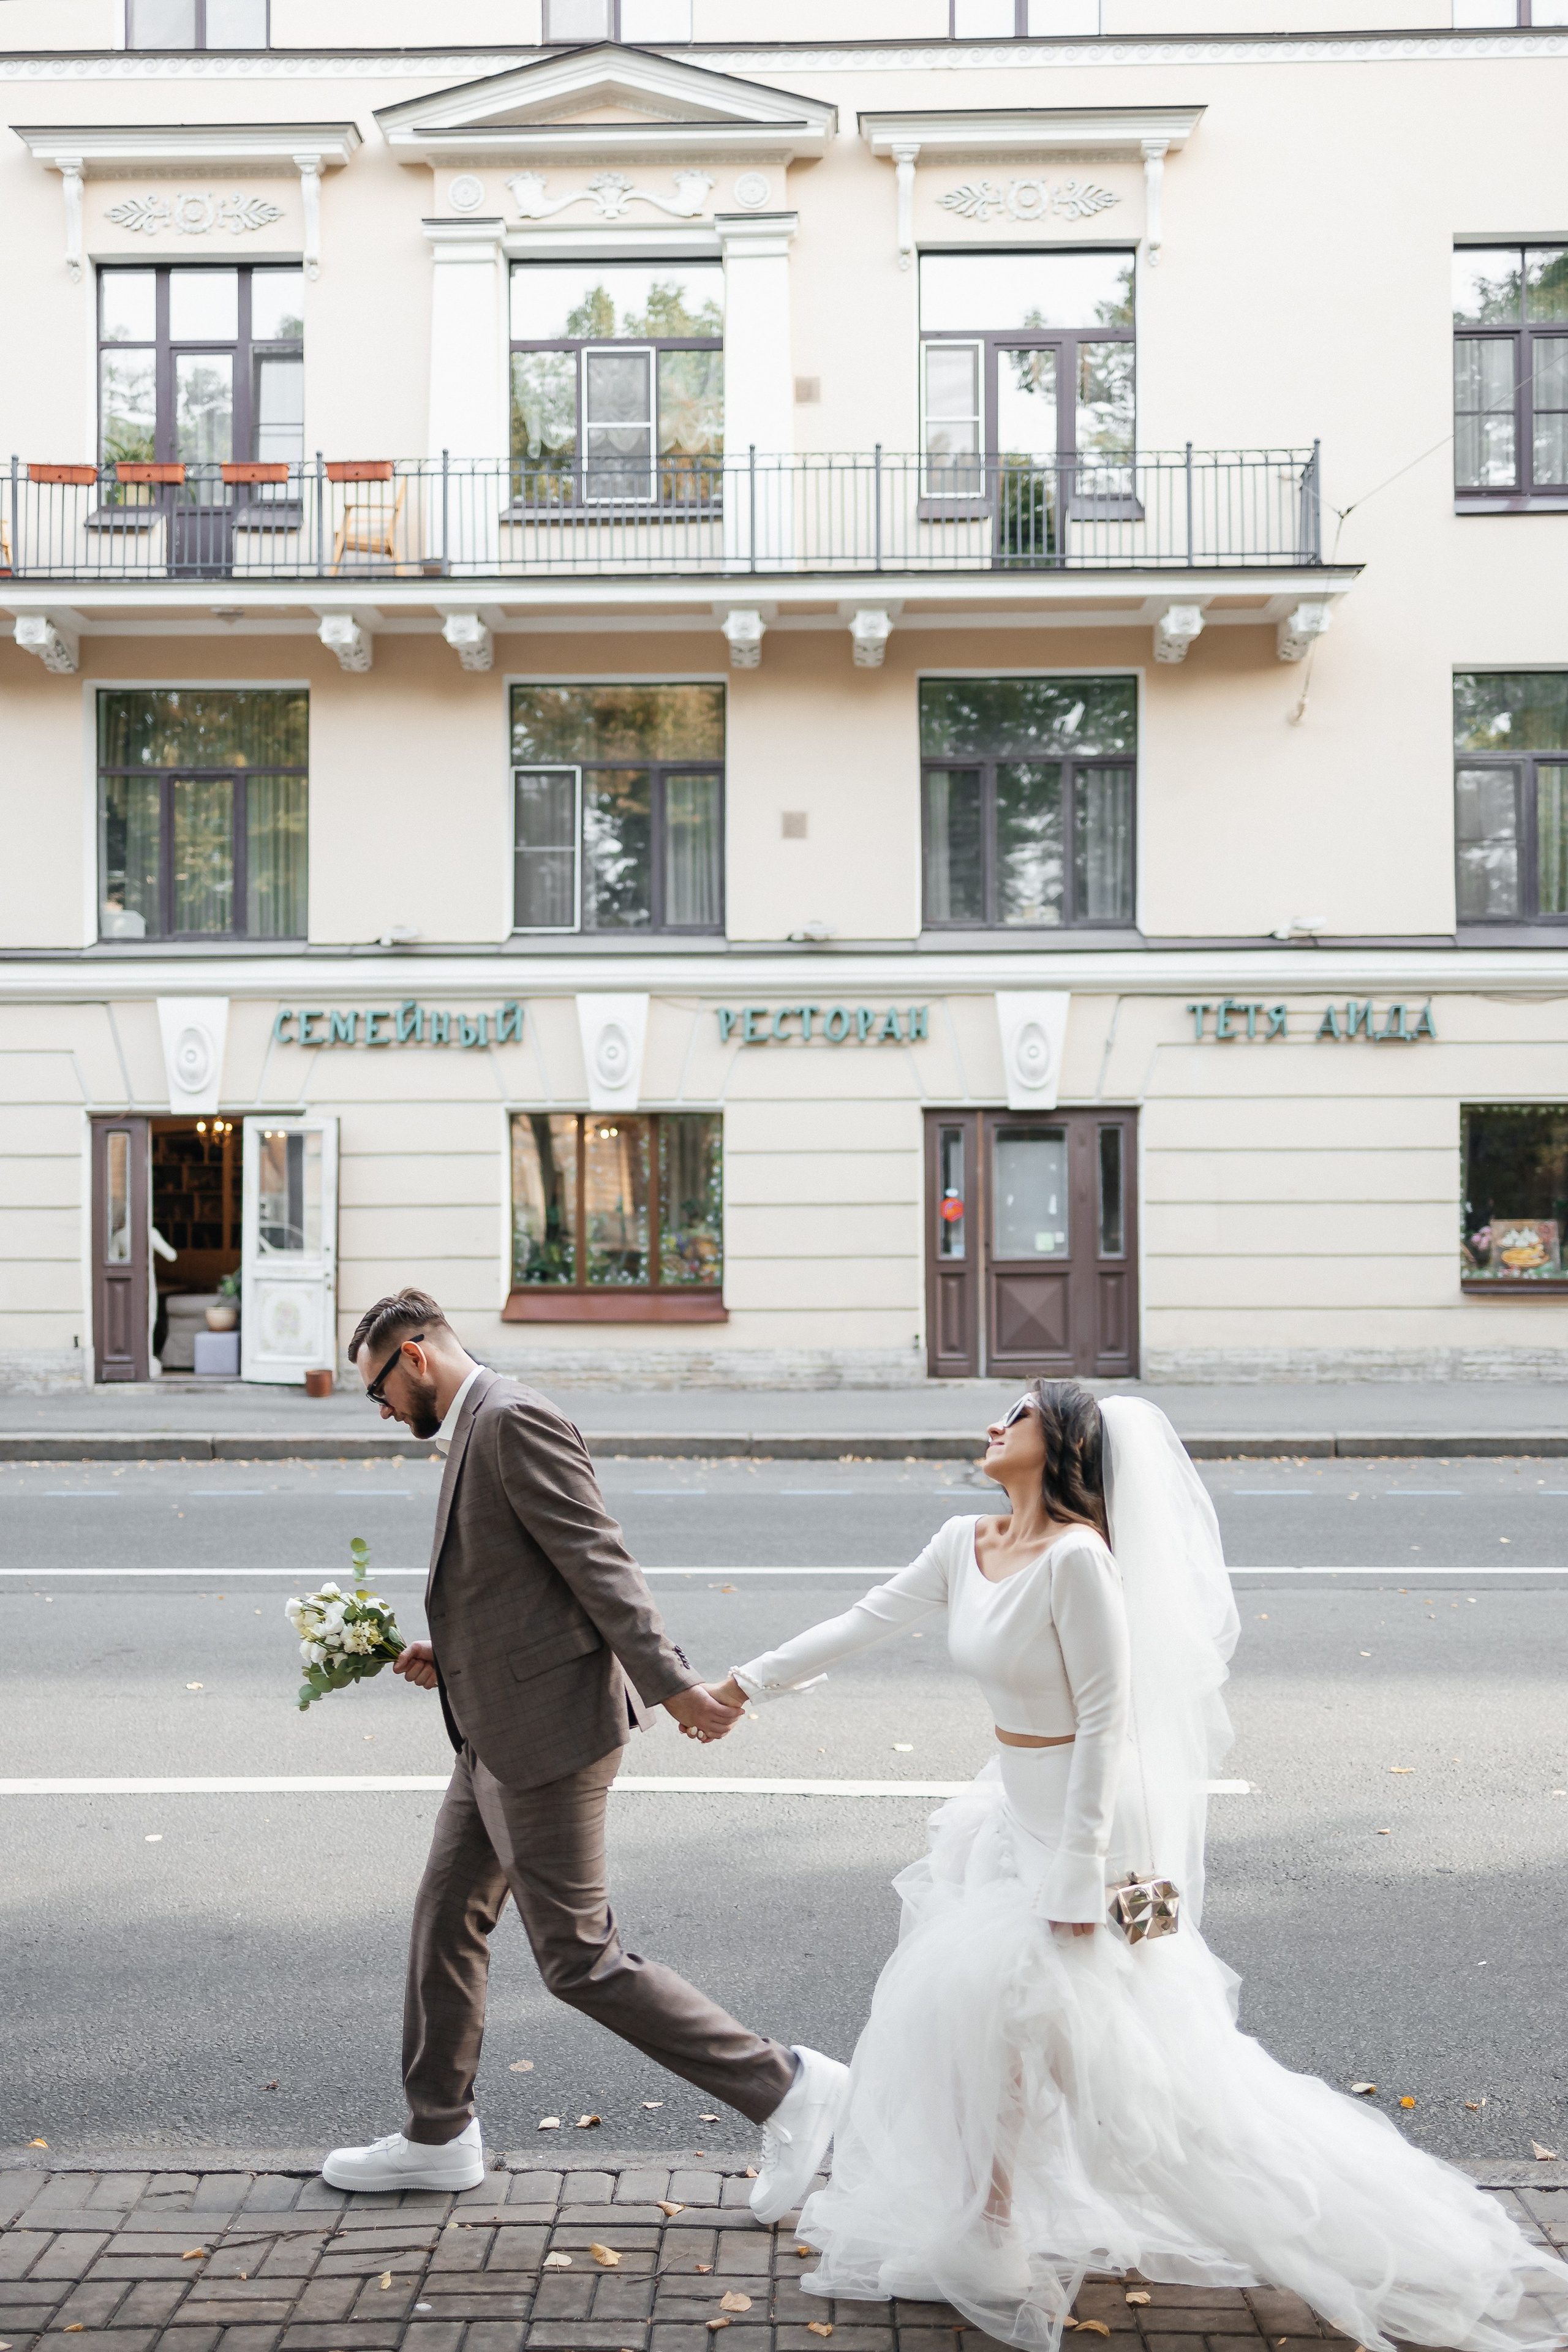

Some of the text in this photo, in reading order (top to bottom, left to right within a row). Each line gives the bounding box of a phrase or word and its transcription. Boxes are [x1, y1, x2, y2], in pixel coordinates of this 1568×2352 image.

[273, 998, 525, 1047] СЕМЕЙНЫЙ
[715, 1005, 929, 1042] РЕСТОРАН
[1316, 998, 1438, 1041] АИДА
